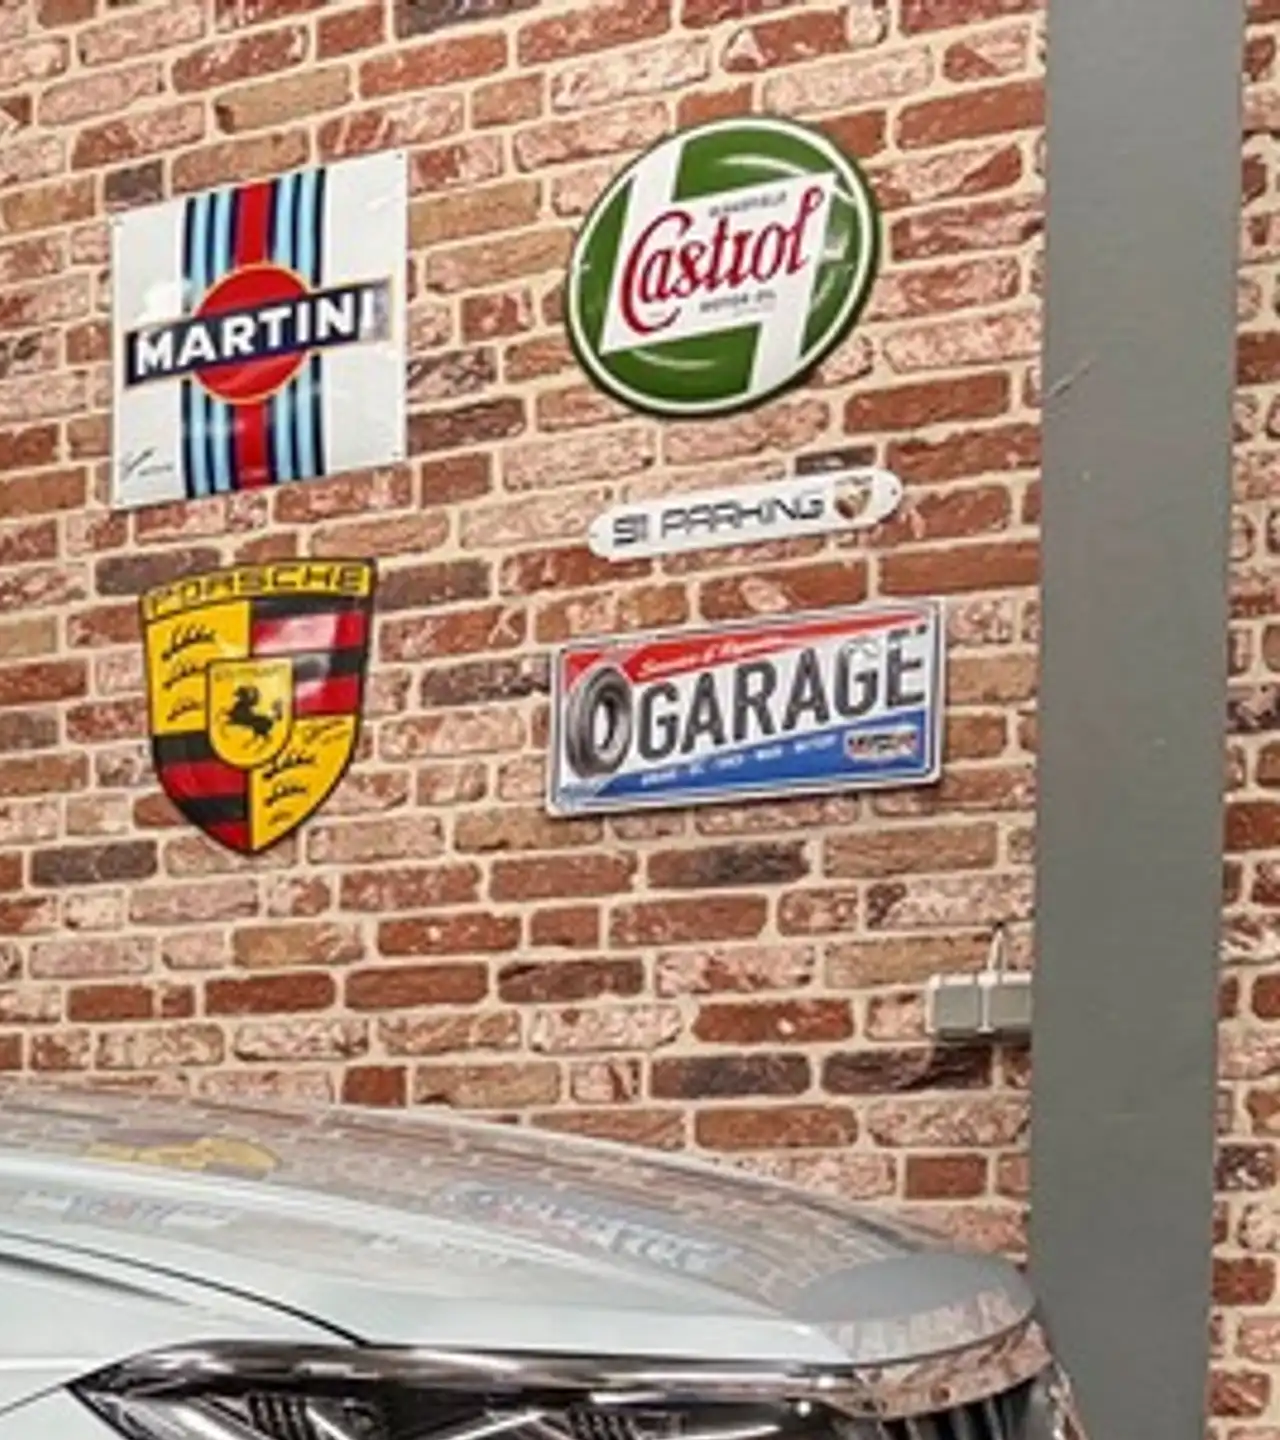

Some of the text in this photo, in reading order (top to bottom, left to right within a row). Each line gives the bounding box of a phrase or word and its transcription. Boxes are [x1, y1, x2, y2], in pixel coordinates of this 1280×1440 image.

[621, 186, 825, 334] Castrol
[134, 290, 376, 378] MARTINI
[660, 498, 826, 540] PARKING
[145, 564, 368, 620] PORSCHE
[638, 624, 930, 761] GARAGE
